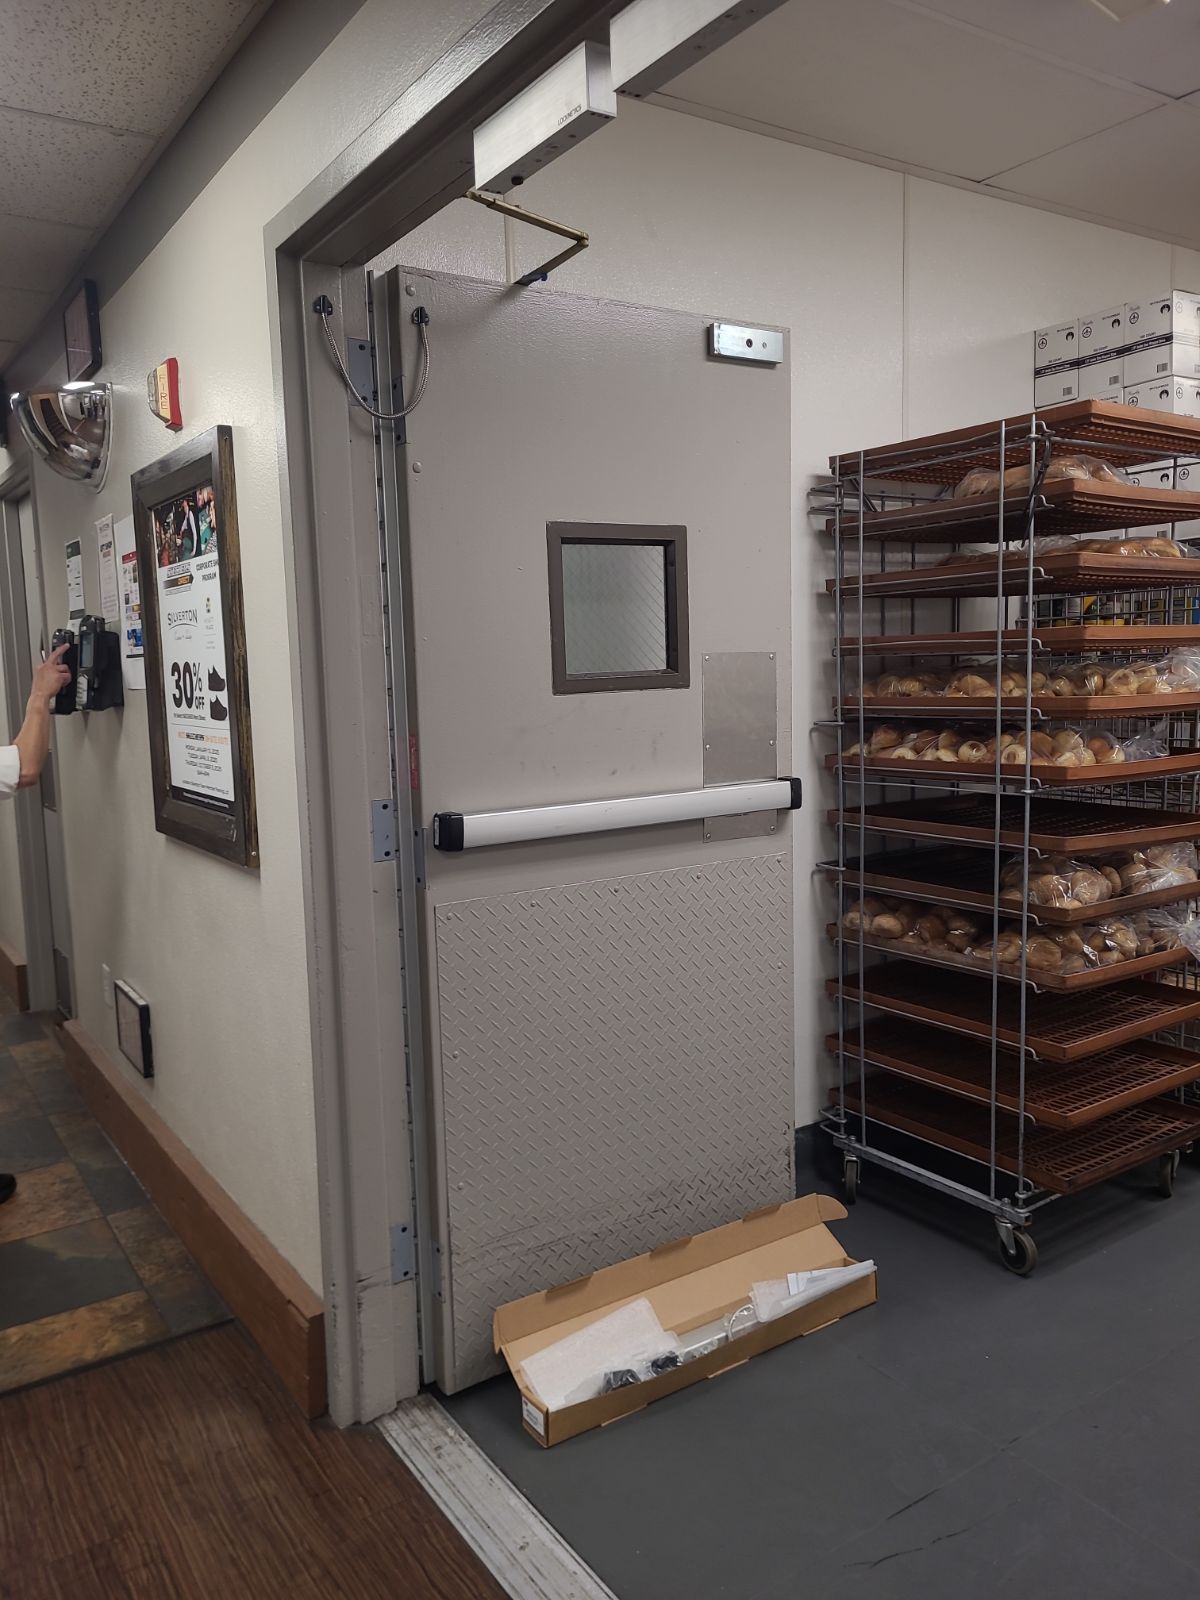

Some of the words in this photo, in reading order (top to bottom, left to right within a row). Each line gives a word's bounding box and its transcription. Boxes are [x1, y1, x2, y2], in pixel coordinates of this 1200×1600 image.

[159, 374, 168, 410] FIRE
[167, 609, 198, 626] SILVERTON
[171, 661, 203, 709] 30%
[195, 696, 205, 710] OFF
